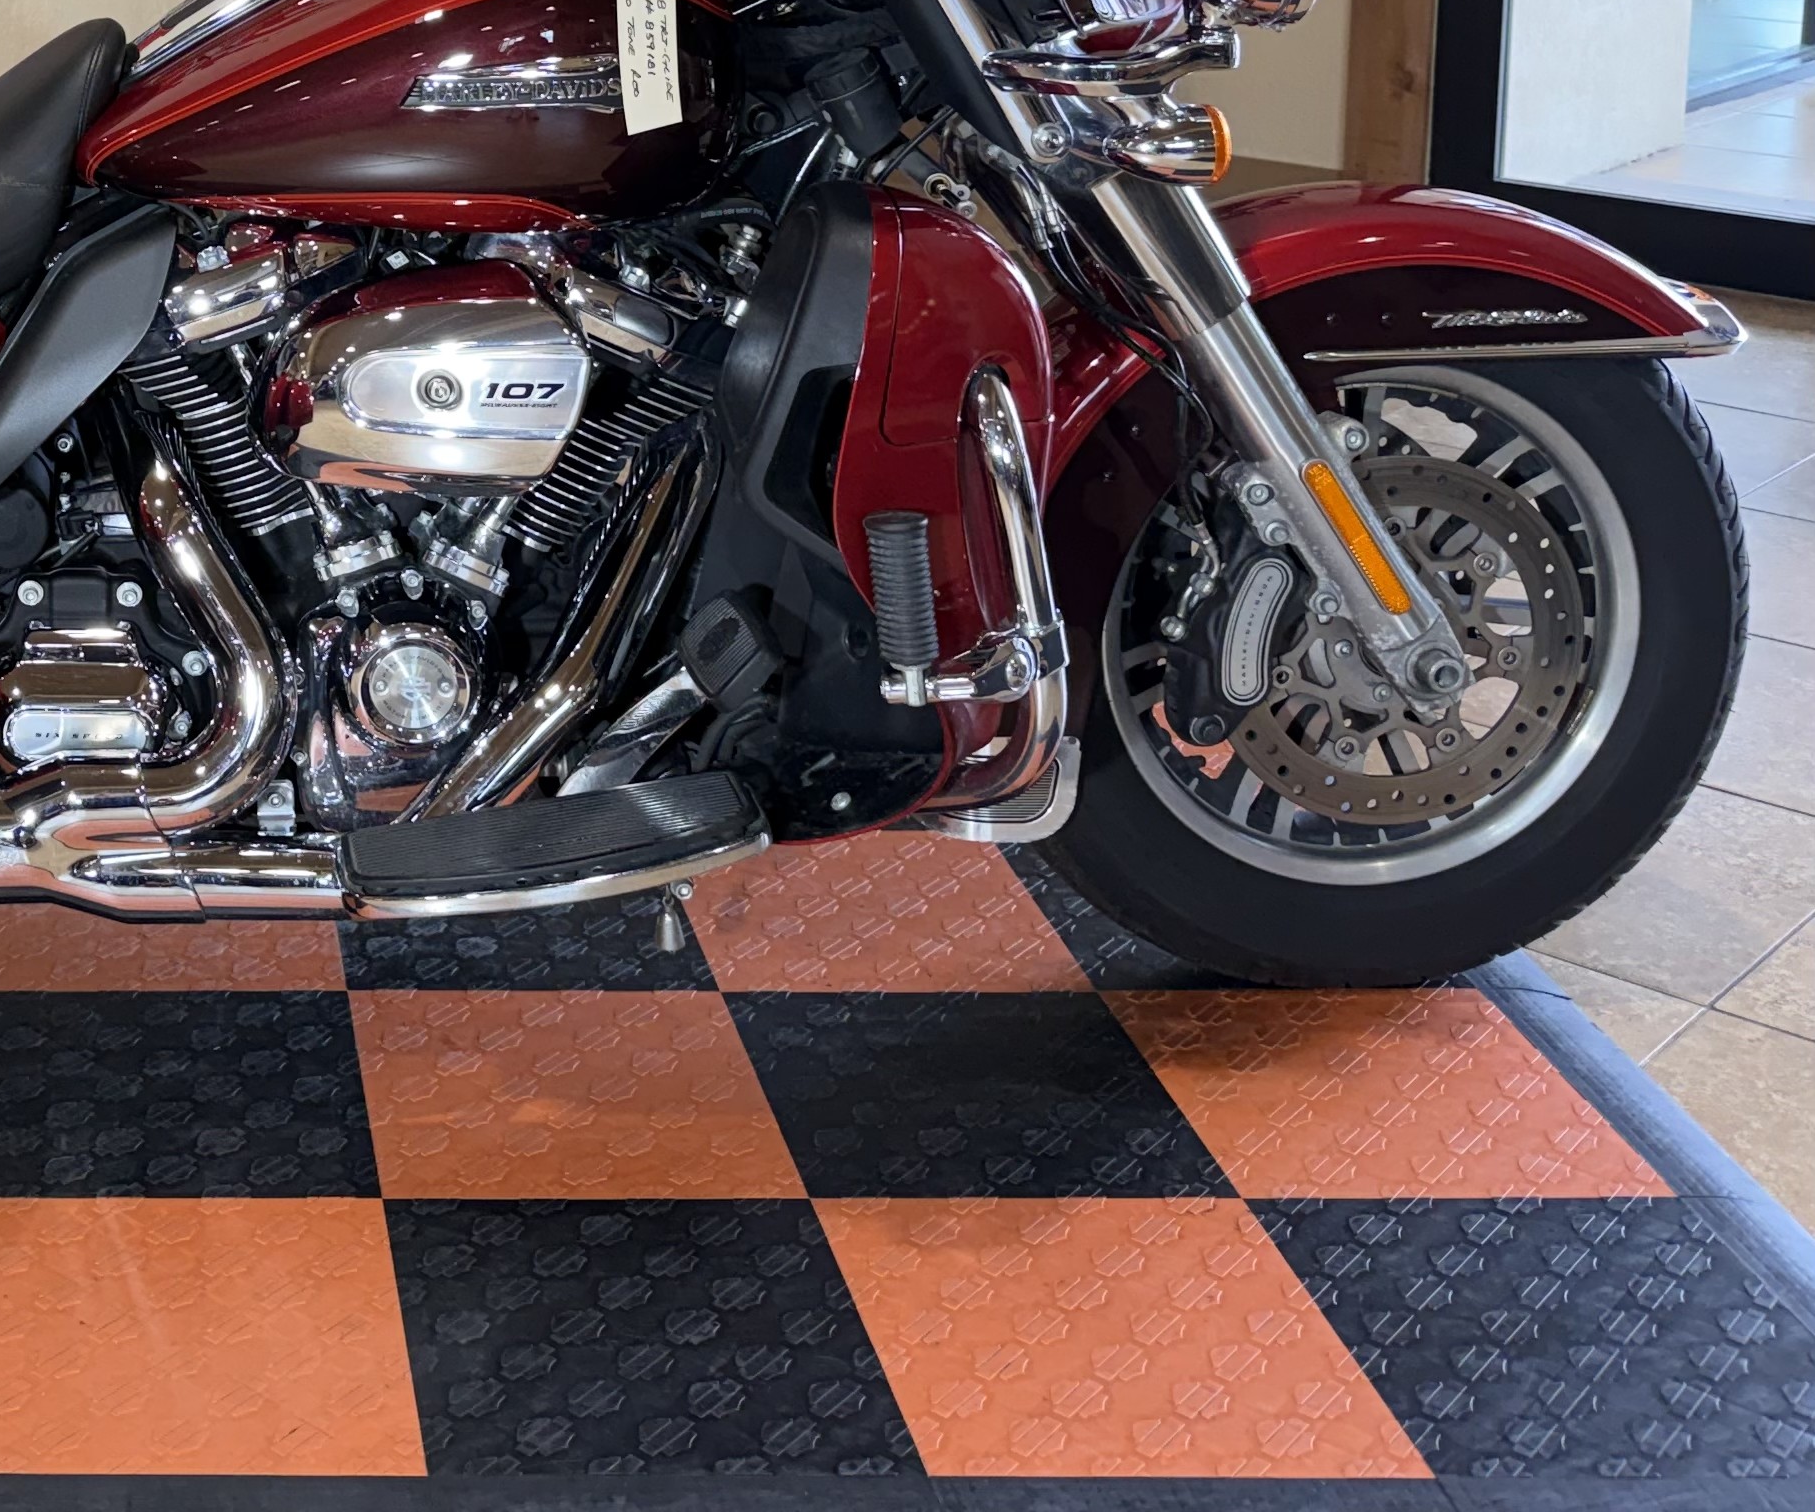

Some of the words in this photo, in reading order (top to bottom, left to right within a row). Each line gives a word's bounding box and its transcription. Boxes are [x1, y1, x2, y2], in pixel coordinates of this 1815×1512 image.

[627, 16, 636, 56] TONE
[421, 76, 622, 103] HARLEY-DAVIDS
[486, 383, 565, 399] 107
